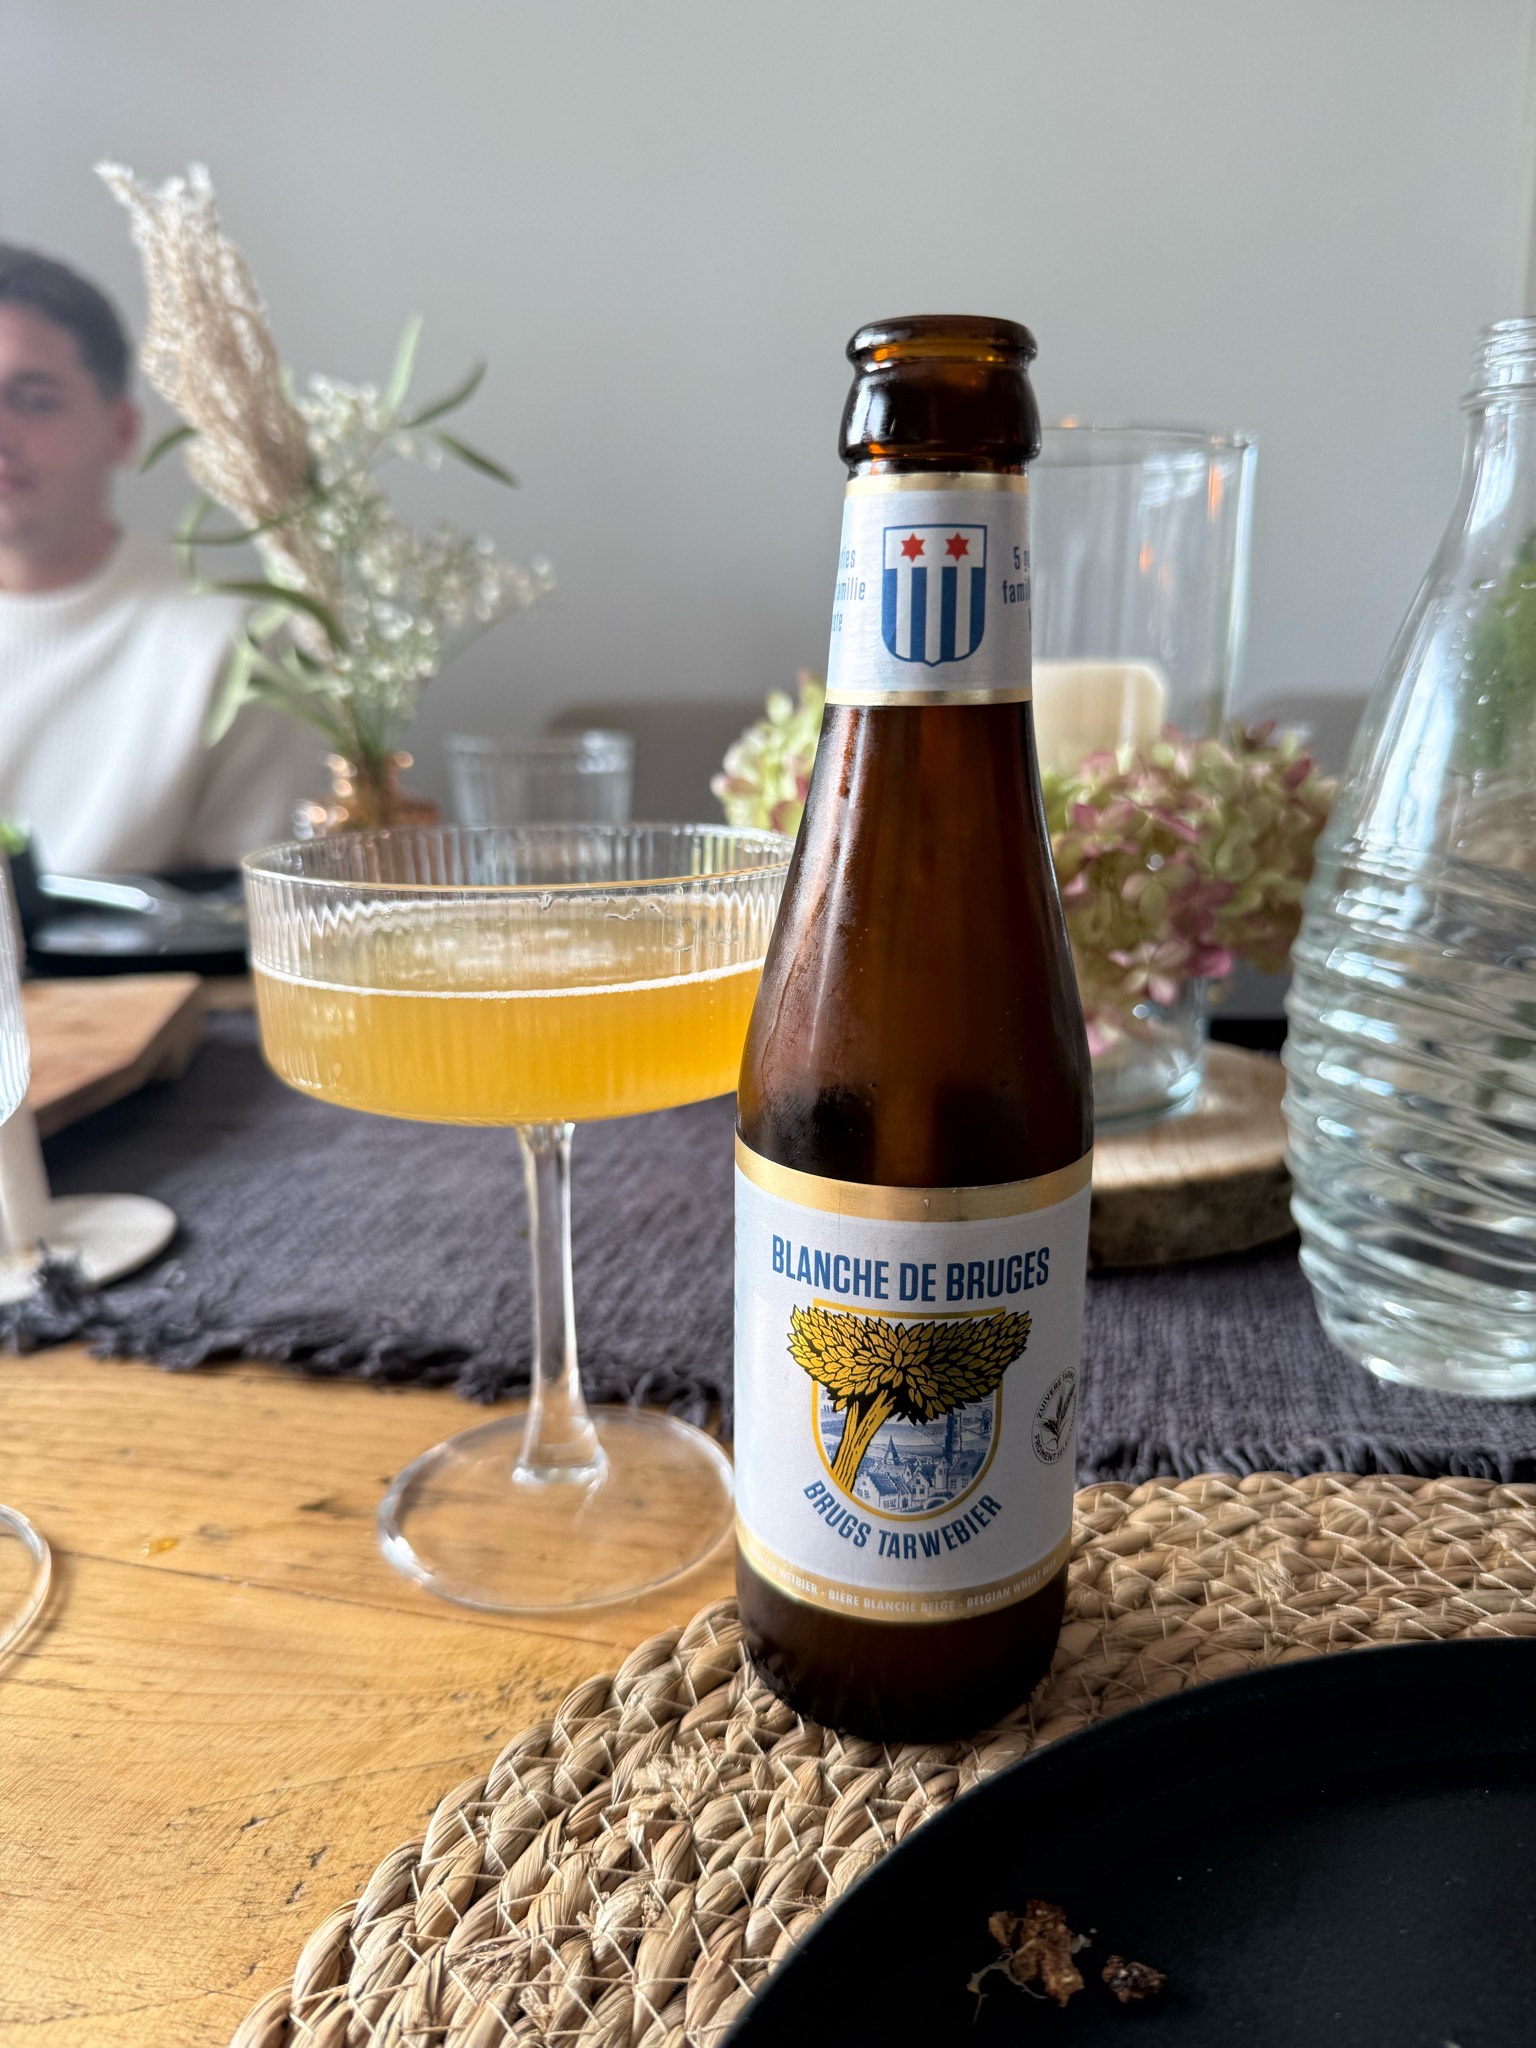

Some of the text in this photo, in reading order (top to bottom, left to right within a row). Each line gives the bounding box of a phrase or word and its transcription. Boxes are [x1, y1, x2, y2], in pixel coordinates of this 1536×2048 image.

[1013, 546, 1021, 570] 5
[835, 577, 866, 601] amilie
[772, 1233, 889, 1300] BLANCHE
[899, 1263, 936, 1302] DE
[946, 1246, 1050, 1302] BRUGES
[1036, 1377, 1062, 1419] ZUIVERE
[803, 1480, 1003, 1560] BRUGS TARWEBIER
[780, 1569, 818, 1595] WITBIER
[828, 1588, 860, 1607] BIÈRE
[863, 1597, 917, 1613] BLANCHE
[920, 1600, 955, 1613] BELGE
[966, 1585, 1010, 1608] BELGIAN
[1013, 1570, 1041, 1594] WHEAT
